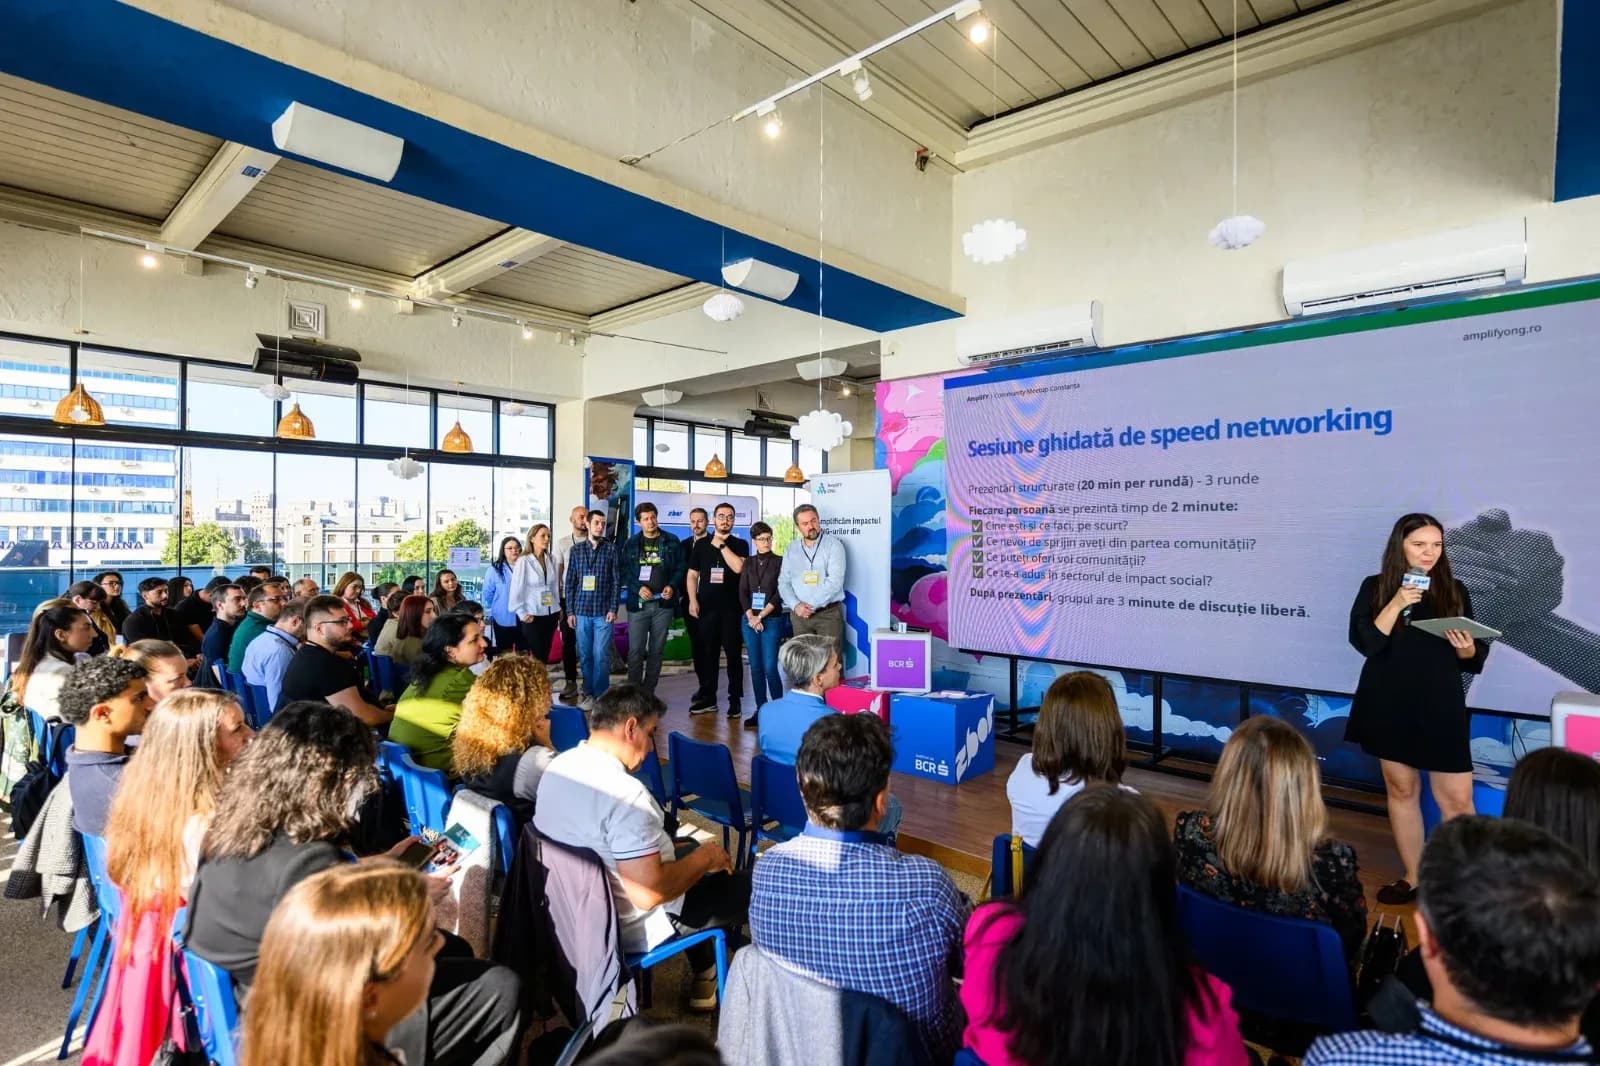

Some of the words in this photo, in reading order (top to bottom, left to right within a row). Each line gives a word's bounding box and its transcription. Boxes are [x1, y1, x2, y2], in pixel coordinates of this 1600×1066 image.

[1463, 324, 1542, 341] amplifyong.ro
[994, 390, 1026, 399] Community
[1026, 386, 1049, 395] Meetup
[968, 436, 1034, 457] Sesiune
[1038, 427, 1114, 457] ghidată
[1119, 426, 1146, 446] de
[1150, 419, 1220, 449] speed
[1227, 407, 1393, 436] networking
[968, 484, 1015, 494] Prezentări
[1018, 482, 1074, 493] structurate
[1077, 480, 1095, 492] (20
[1098, 478, 1121, 490] min
[1125, 479, 1145, 492] per
[1149, 475, 1194, 488] rundă)
[1205, 475, 1213, 486] 3
[1217, 473, 1260, 486] runde
[969, 506, 1004, 515] Fiecare
[1006, 504, 1055, 517] persoană
[1058, 506, 1070, 514] se
[1073, 504, 1118, 517] prezintă
[1121, 502, 1149, 516] timp
[1152, 501, 1168, 513] de
[1171, 501, 1179, 513] 2
[1183, 500, 1238, 512] minute:
[819, 517, 851, 526] mplificăm
[852, 516, 881, 526] impactul
[985, 521, 1007, 531] Cine
[1053, 520, 1074, 532] faci,
[1077, 523, 1091, 532] pe
[1094, 520, 1129, 531] scurt?
[850, 527, 861, 535] din
[986, 537, 998, 546] Ce
[1001, 537, 1026, 547] nevoi
[1029, 537, 1042, 547] de
[1044, 537, 1076, 550] sprijin
[1109, 537, 1127, 549] din
[1130, 538, 1170, 551] partea
[1173, 538, 1257, 552] comunității?
[986, 552, 998, 562] Ce
[1031, 553, 1055, 563] oferi
[1057, 554, 1073, 564] voi
[1076, 555, 1146, 568] comunității?
[986, 568, 998, 577] Ce
[1021, 569, 1046, 579] adus
[1060, 571, 1105, 582] sectorul
[1107, 572, 1122, 583] de
[1125, 573, 1167, 587] impact
[1170, 575, 1213, 587] social?
[970, 587, 995, 599] După
[1057, 594, 1093, 606] grupul
[1096, 596, 1115, 605] are
[1118, 596, 1125, 606] 3
[1128, 597, 1175, 610] minute
[1178, 599, 1195, 611] de
[1199, 600, 1257, 617] discuție
[1260, 603, 1311, 618] liberă.
